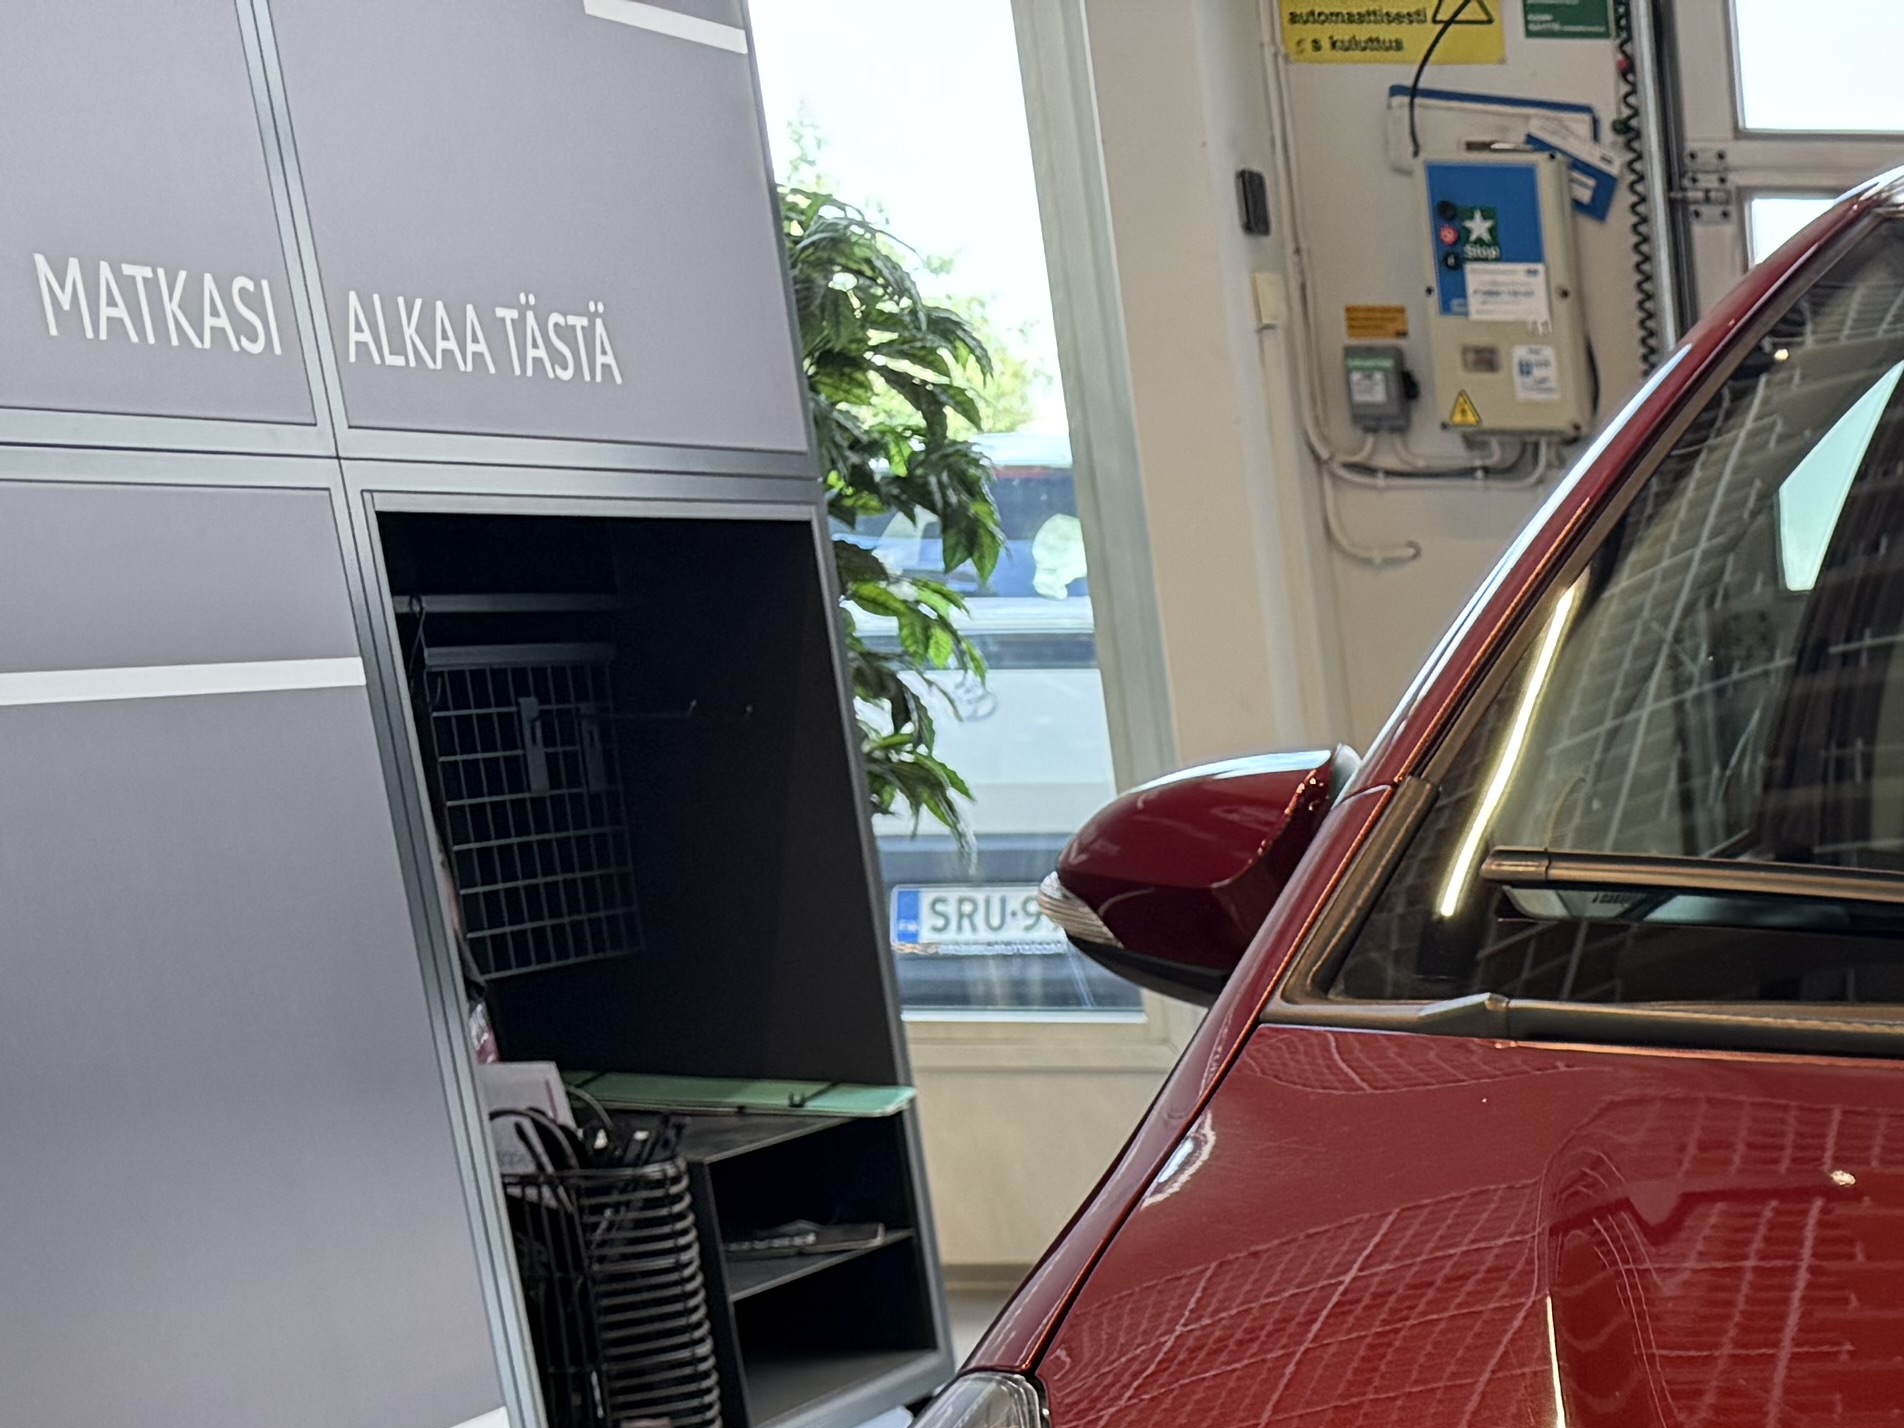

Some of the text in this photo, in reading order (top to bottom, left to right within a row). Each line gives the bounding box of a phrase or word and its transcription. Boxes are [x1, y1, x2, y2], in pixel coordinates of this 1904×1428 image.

[33, 253, 624, 385] MATKASI ALKAA TÄSTÄ
[929, 895, 1045, 933] SRU-9
